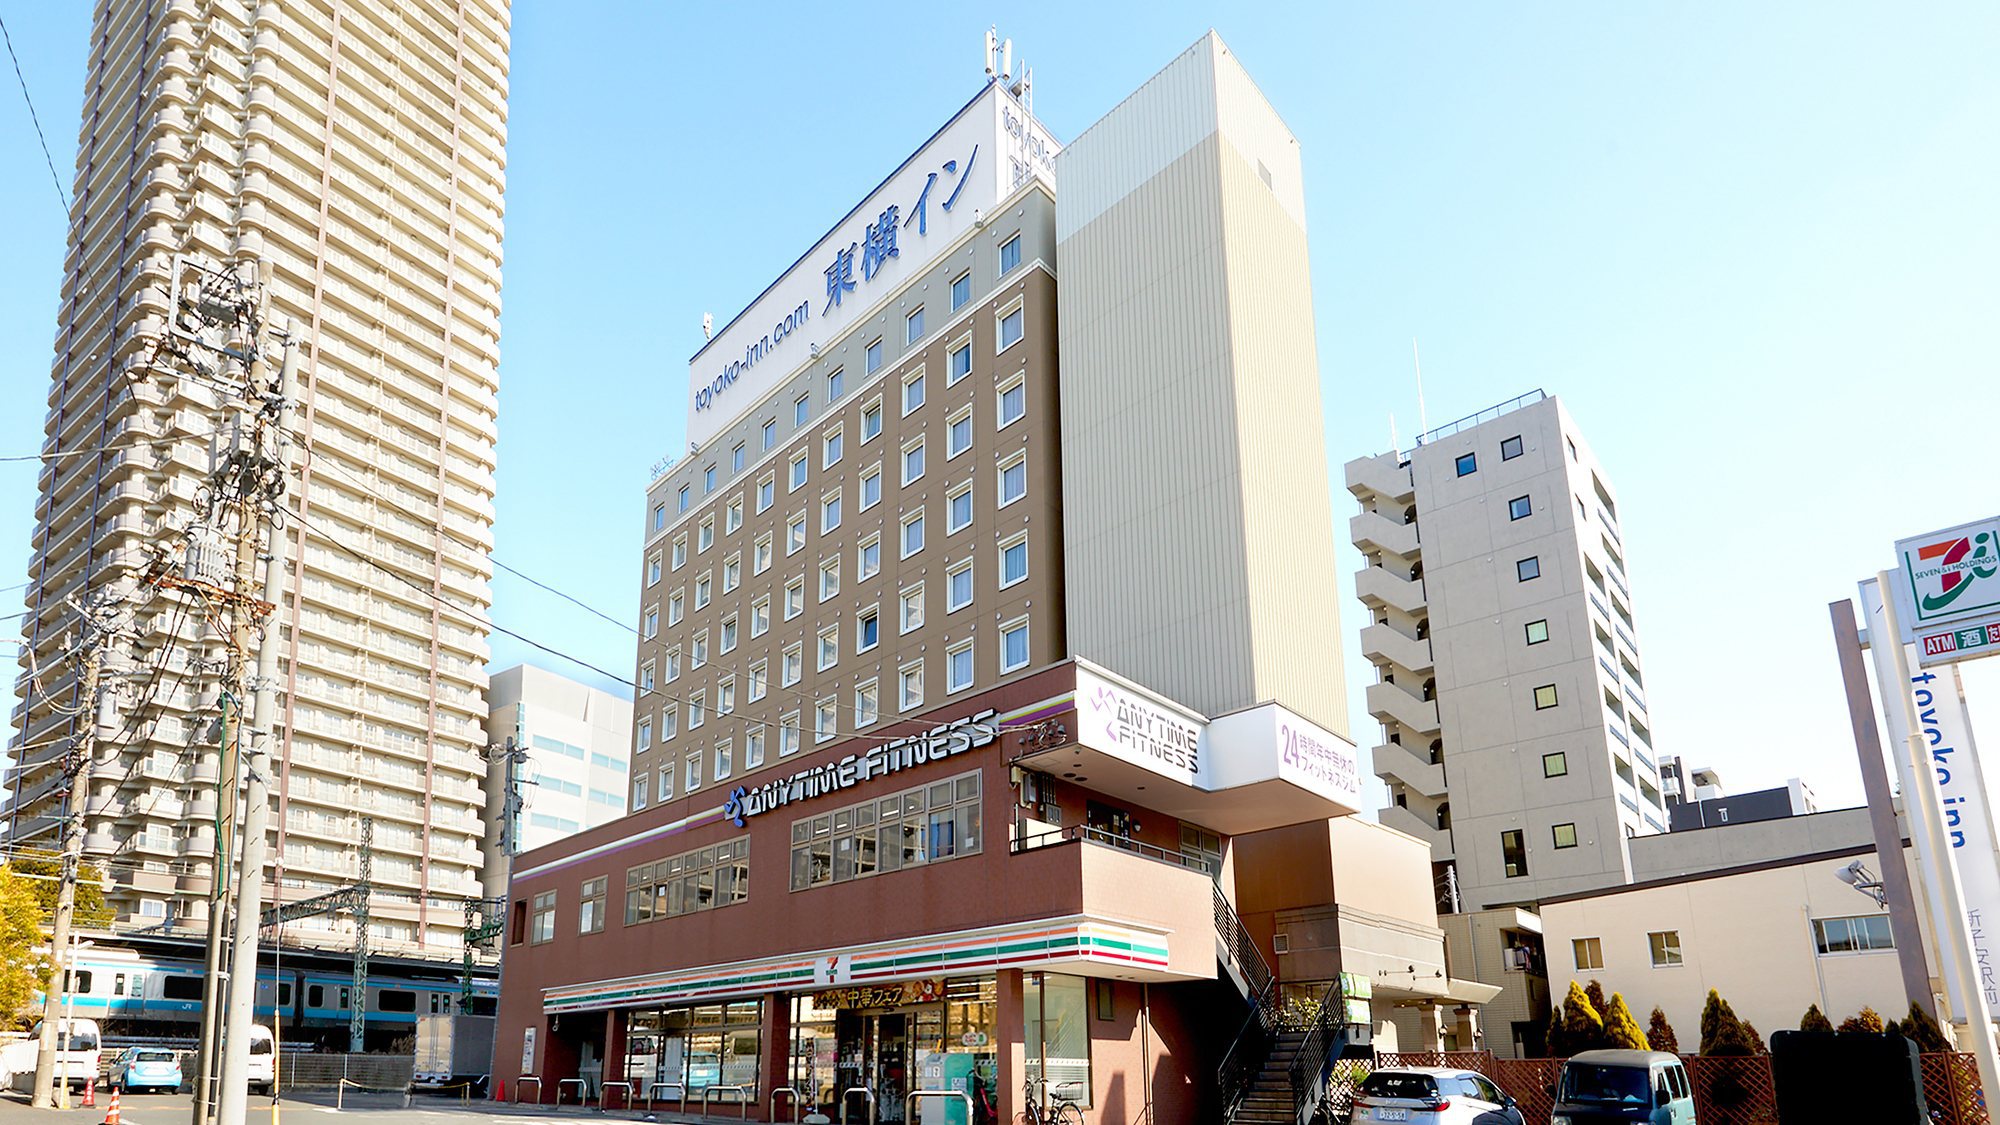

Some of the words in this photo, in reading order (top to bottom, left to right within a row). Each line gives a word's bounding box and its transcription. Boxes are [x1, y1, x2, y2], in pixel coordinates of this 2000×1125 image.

[695, 300, 809, 411] toyoko-inn.com
[822, 144, 979, 317] 東横イン
[1952, 555, 1998, 571] HOLDINGS
[1926, 634, 1955, 654] ATM
[1961, 629, 1982, 647] 酒
[1117, 698, 1198, 753] ANYTIME
[1119, 724, 1199, 775] FITNESS
[1282, 724, 1299, 769] 24
[747, 754, 857, 818] ANYTIME
[865, 708, 996, 781] FITNESS
[1943, 797, 1966, 849] inn
[847, 987, 903, 1008] 中華フェア
